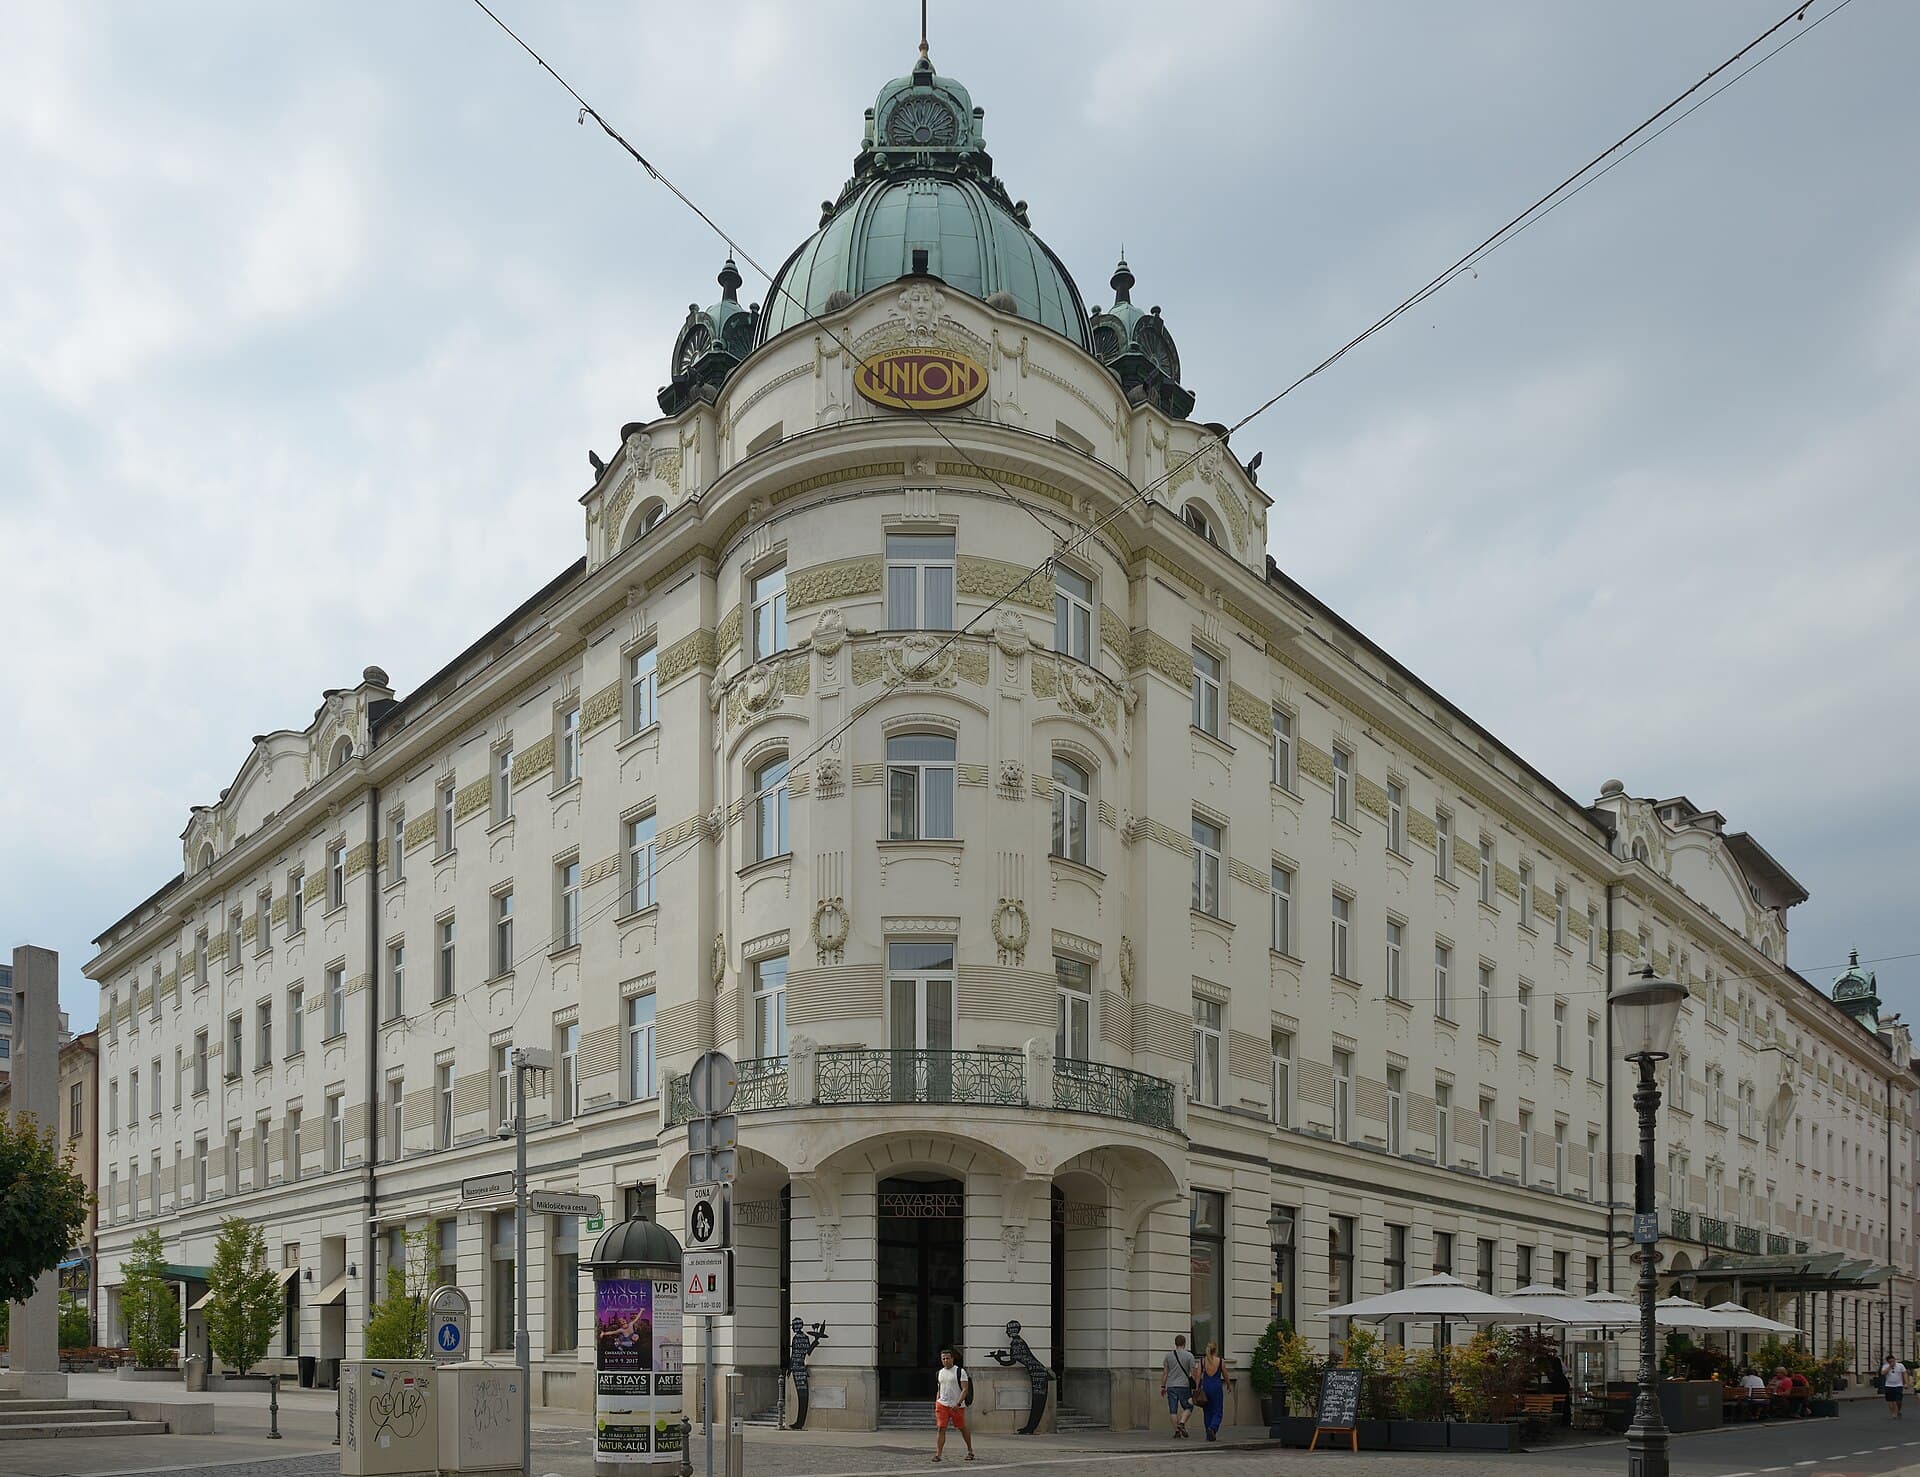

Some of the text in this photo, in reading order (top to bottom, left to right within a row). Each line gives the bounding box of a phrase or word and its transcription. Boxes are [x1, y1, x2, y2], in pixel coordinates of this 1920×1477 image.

[884, 348, 959, 358] GRAND HOTEL
[872, 361, 971, 397] UNION
[694, 1190, 710, 1199] CONA
[883, 1194, 959, 1207] KAVARNA
[572, 1204, 587, 1212] cesta
[895, 1205, 946, 1217] UNION
[654, 1282, 678, 1294] VPIS
[599, 1375, 647, 1385] ART STAYS
[658, 1375, 674, 1385] ART
[599, 1441, 647, 1452] NATUR-AL(L)
